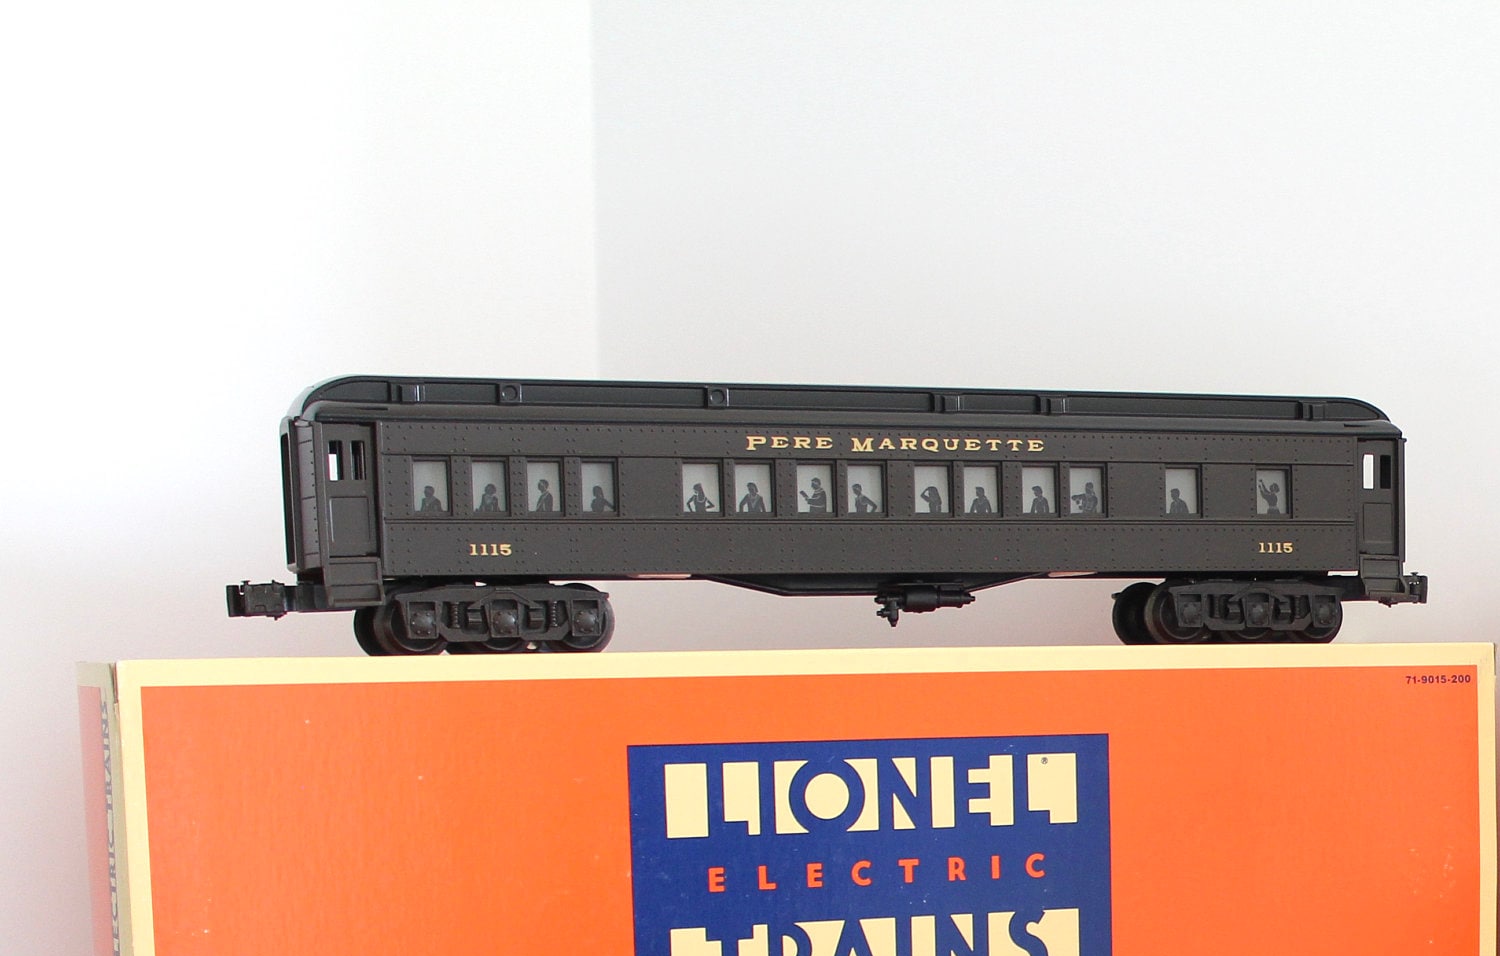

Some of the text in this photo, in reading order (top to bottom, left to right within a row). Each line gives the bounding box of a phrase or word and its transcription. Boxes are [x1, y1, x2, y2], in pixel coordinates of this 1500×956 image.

[746, 434, 1045, 452] PERE MARQUETTE
[469, 542, 512, 556] 1115
[1258, 541, 1294, 553] 1115
[1405, 674, 1471, 685] 71-9015-200
[688, 754, 1064, 838] LIONEL
[707, 853, 1046, 893] ELECTRIC
